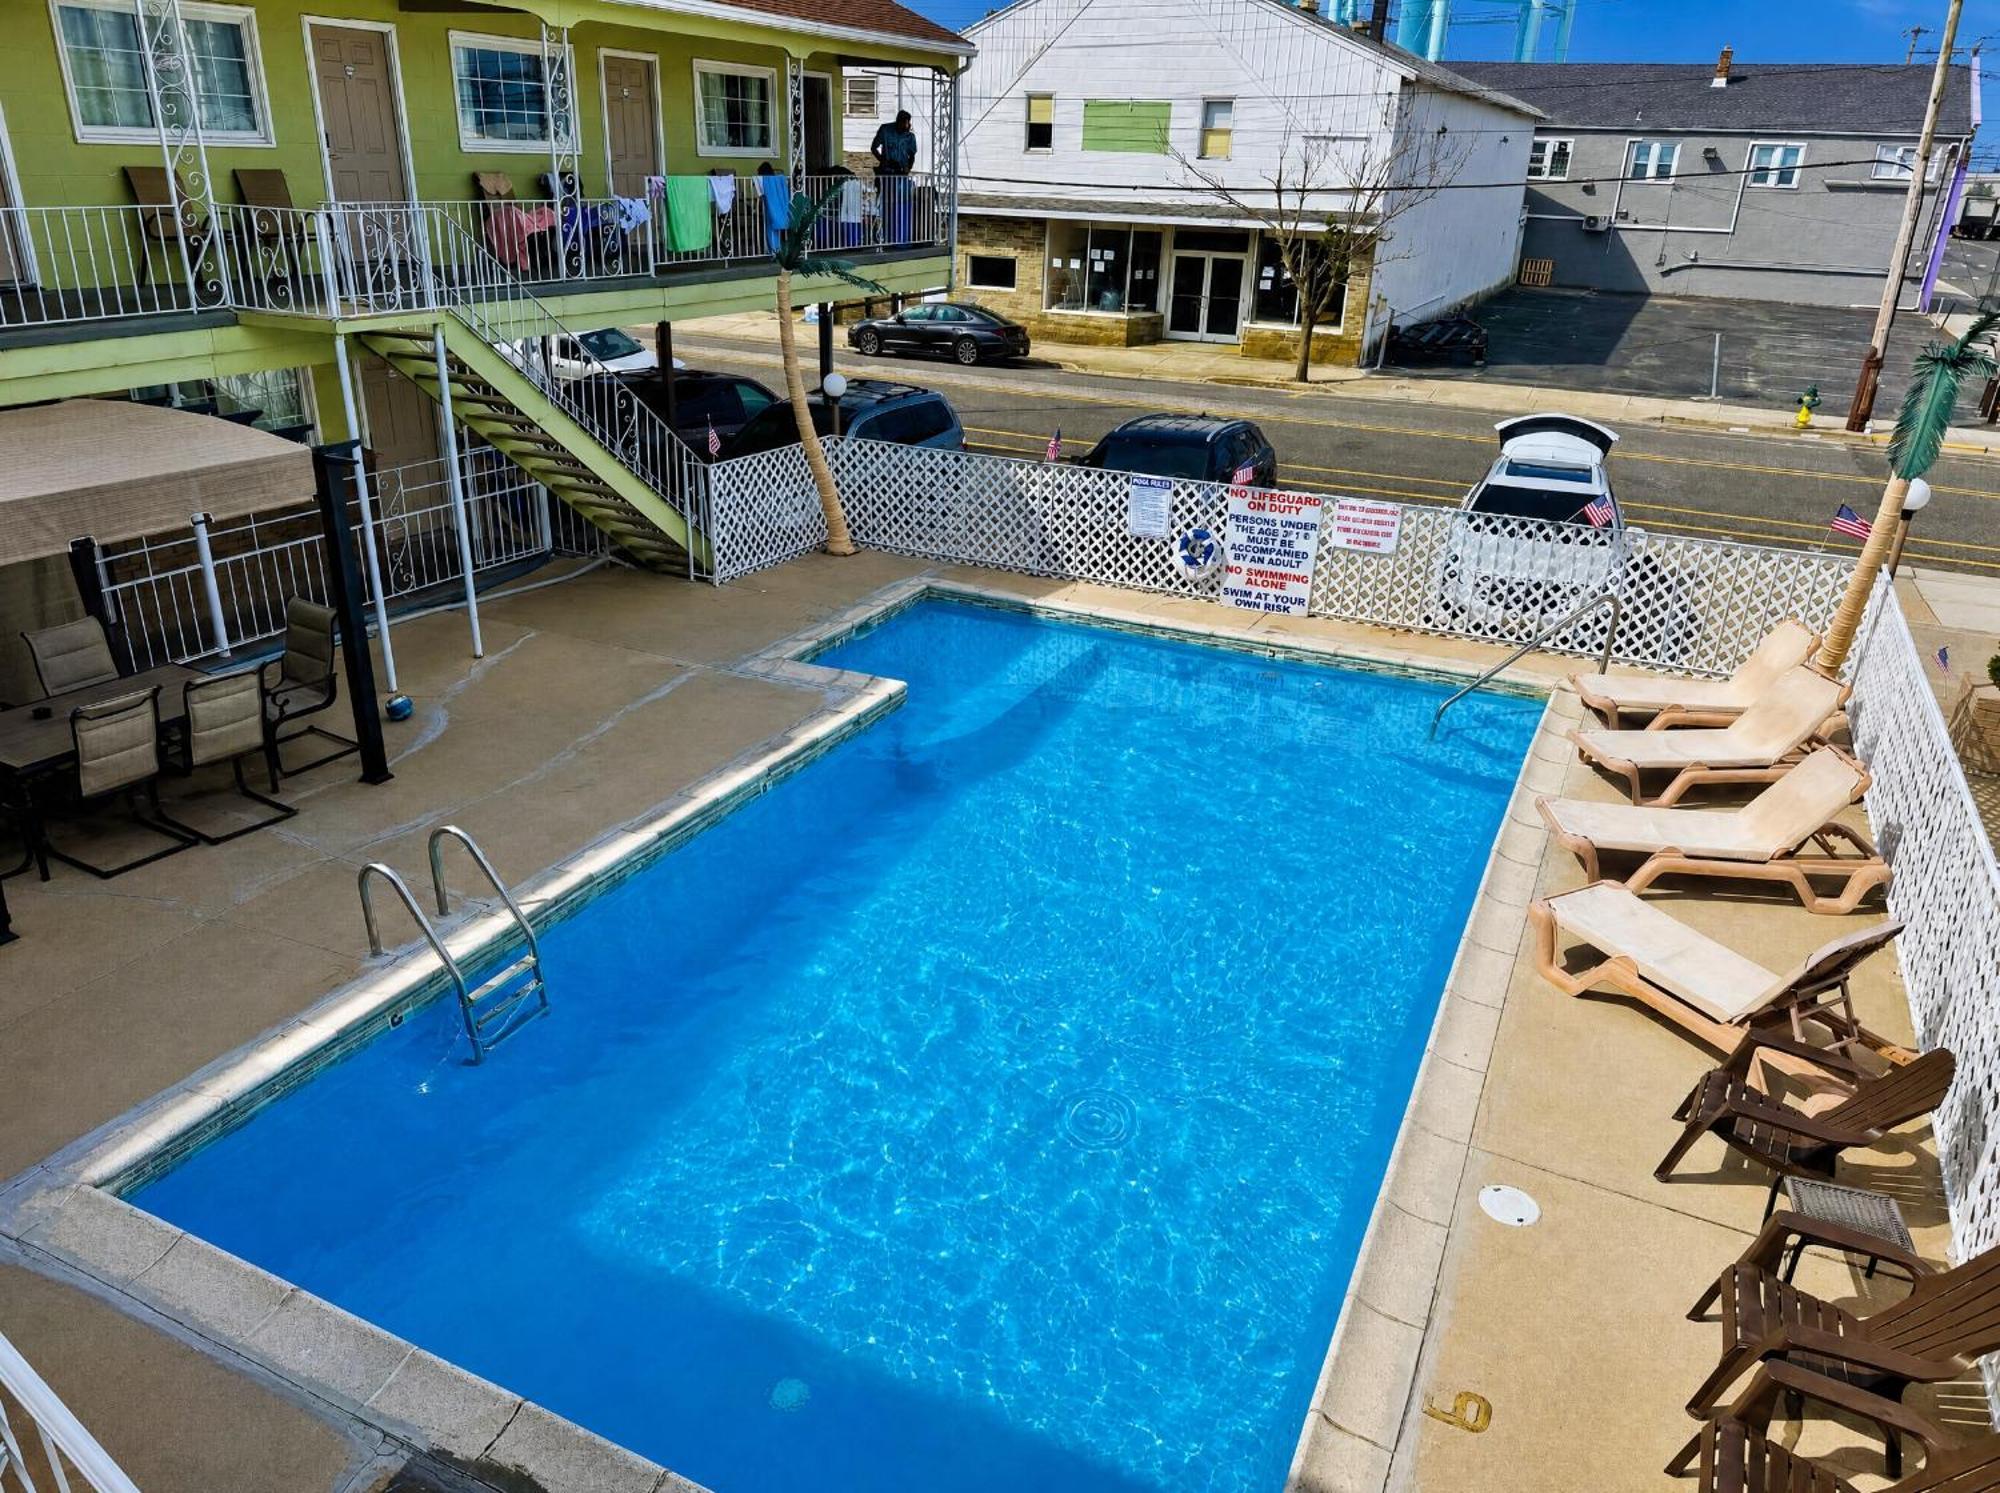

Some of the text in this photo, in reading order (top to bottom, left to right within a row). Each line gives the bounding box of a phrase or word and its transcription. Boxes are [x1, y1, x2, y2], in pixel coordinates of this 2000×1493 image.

[1230, 488, 1321, 507] NO LIFEGUARD
[1248, 500, 1303, 515] ON DUTY
[1229, 514, 1318, 532] PERSONS UNDER
[1235, 524, 1256, 534] THE
[1257, 527, 1279, 537] AGE
[1246, 535, 1295, 549] MUST BE
[1230, 543, 1309, 560] ACCOMPANIED
[1233, 553, 1303, 569] BY AN ADULT
[1225, 565, 1309, 584] NO SWIMMING
[1245, 577, 1287, 590] ALONE
[1222, 587, 1306, 606] SWIM AT YOUR
[1235, 598, 1291, 614] OWN RISK
